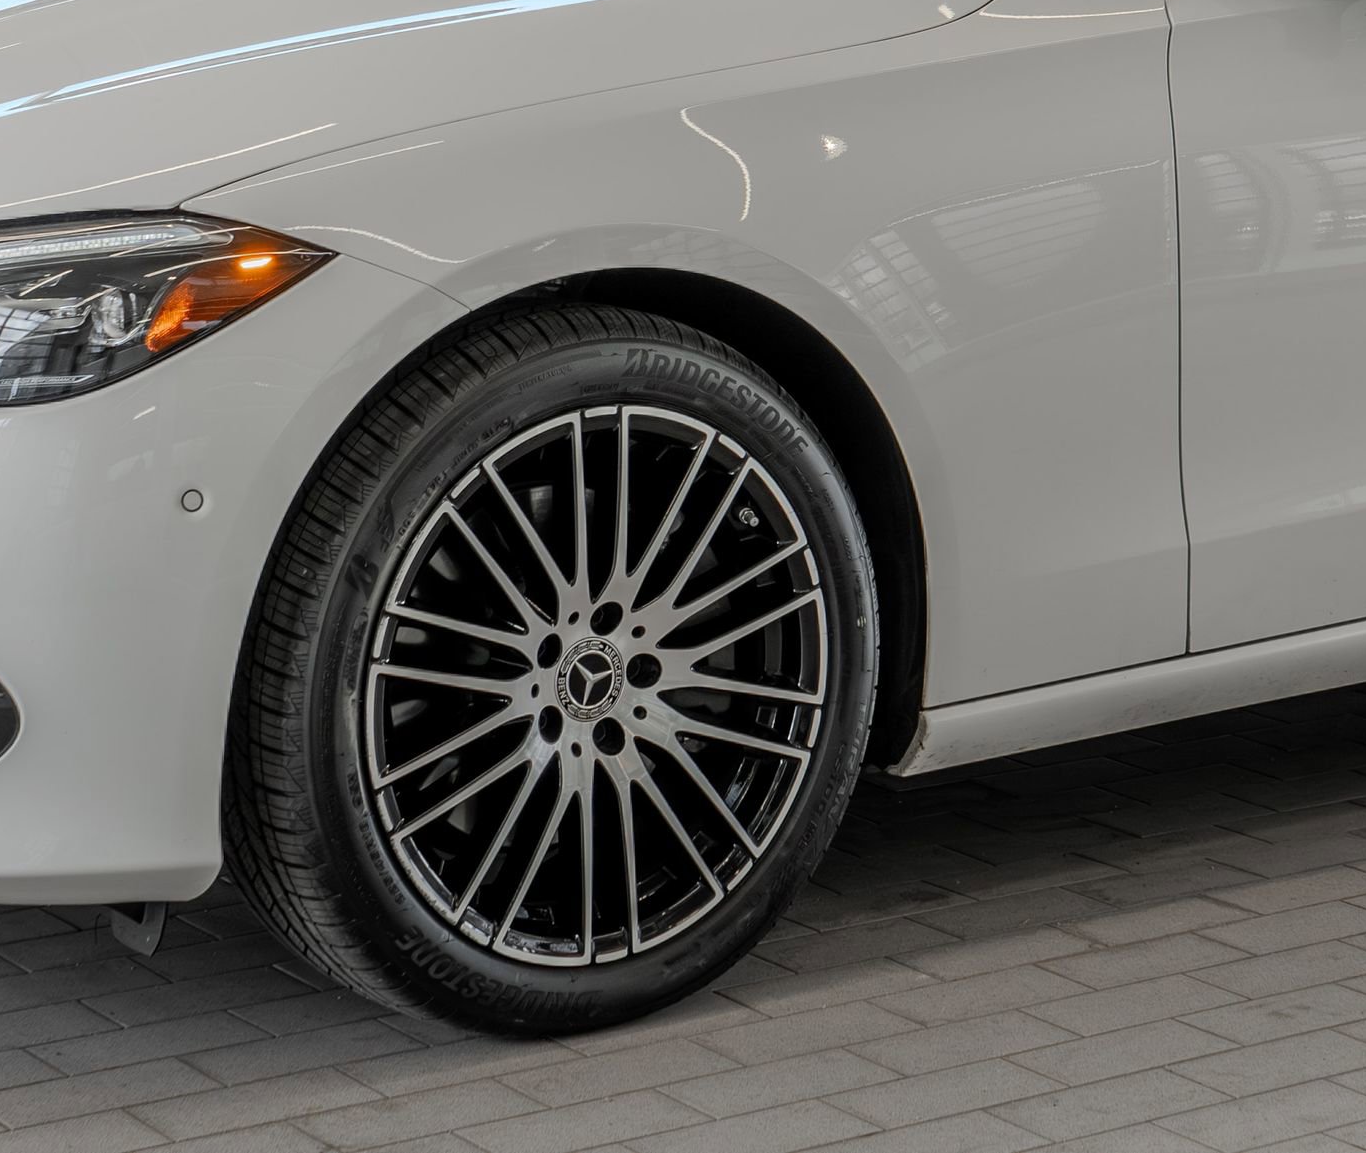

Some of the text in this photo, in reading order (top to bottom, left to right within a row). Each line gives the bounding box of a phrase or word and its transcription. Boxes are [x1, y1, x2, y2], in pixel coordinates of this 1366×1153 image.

[621, 348, 810, 458] BRIDGESTONE
[558, 677, 570, 706] BENZ
[603, 644, 622, 698] MERCEDES
